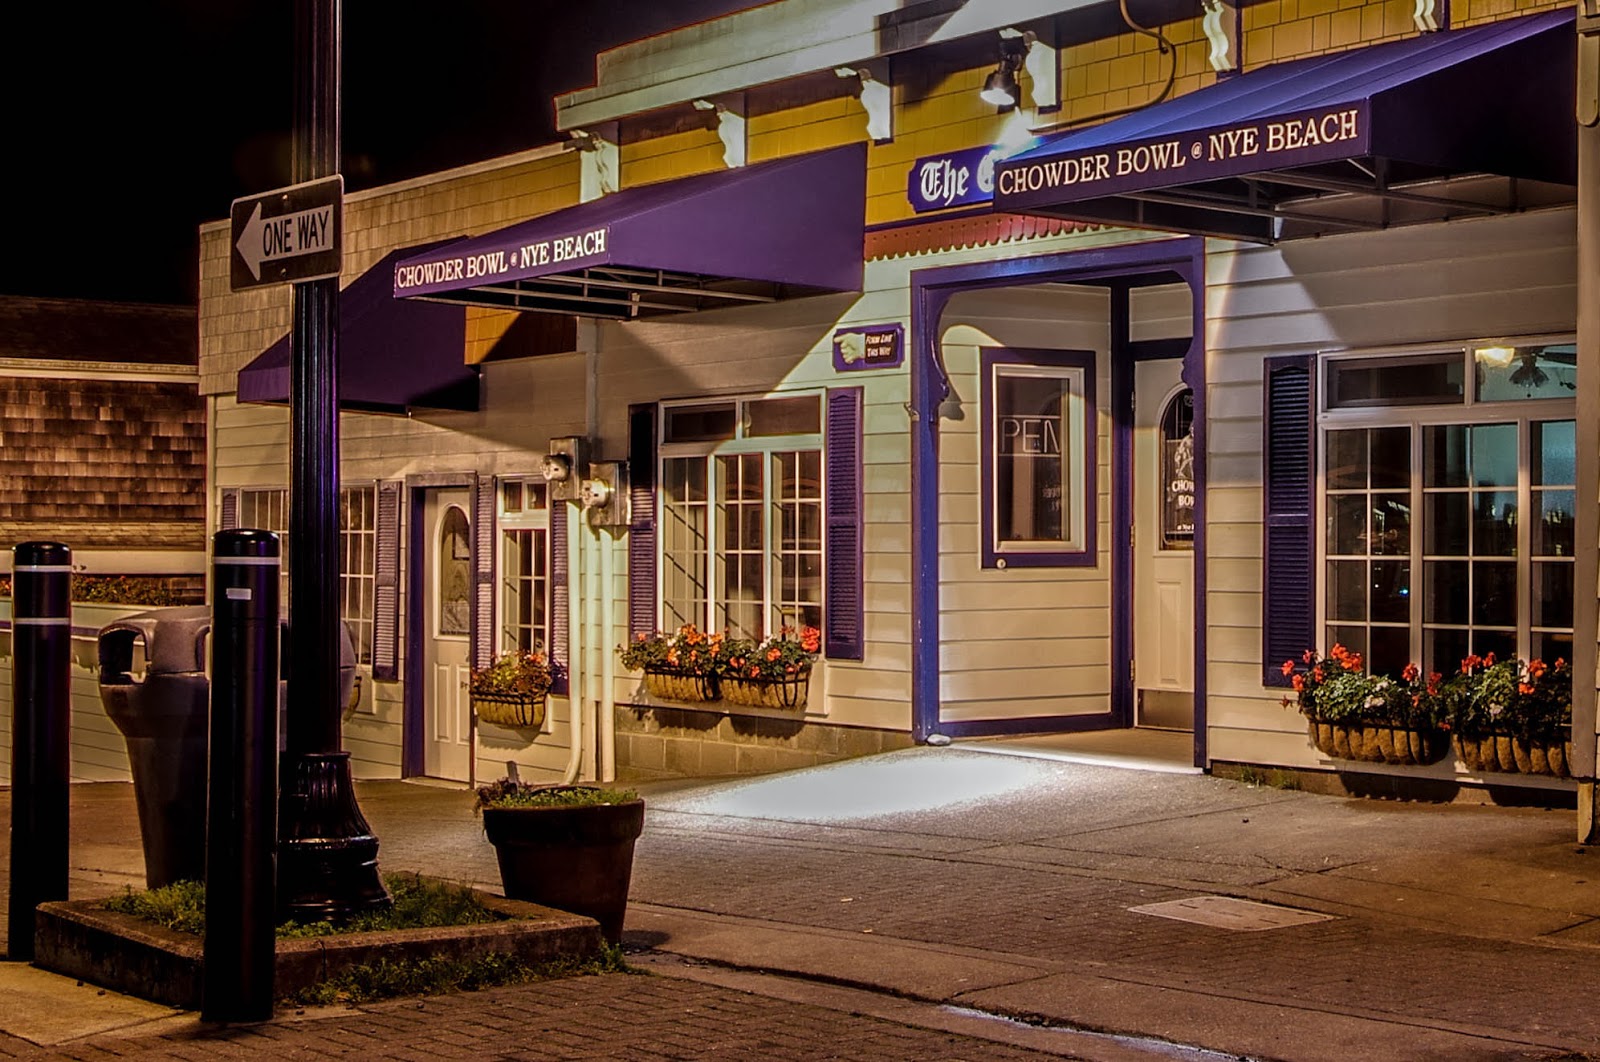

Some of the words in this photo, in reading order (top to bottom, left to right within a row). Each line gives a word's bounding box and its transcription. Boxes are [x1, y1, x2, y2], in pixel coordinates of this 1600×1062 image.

[999, 155, 1110, 195] CHOWDER
[1116, 141, 1186, 176] BOWL
[1191, 142, 1203, 159] @
[1208, 128, 1259, 161] NYE
[1266, 110, 1358, 151] BEACH
[920, 159, 970, 206] The
[263, 218, 292, 257] ONE
[297, 210, 329, 250] WAY
[397, 260, 463, 288] CHOWDER
[466, 251, 508, 278] BOWL
[520, 242, 549, 268] NYE
[553, 229, 606, 262] BEACH
[1001, 418, 1060, 453] PEN
